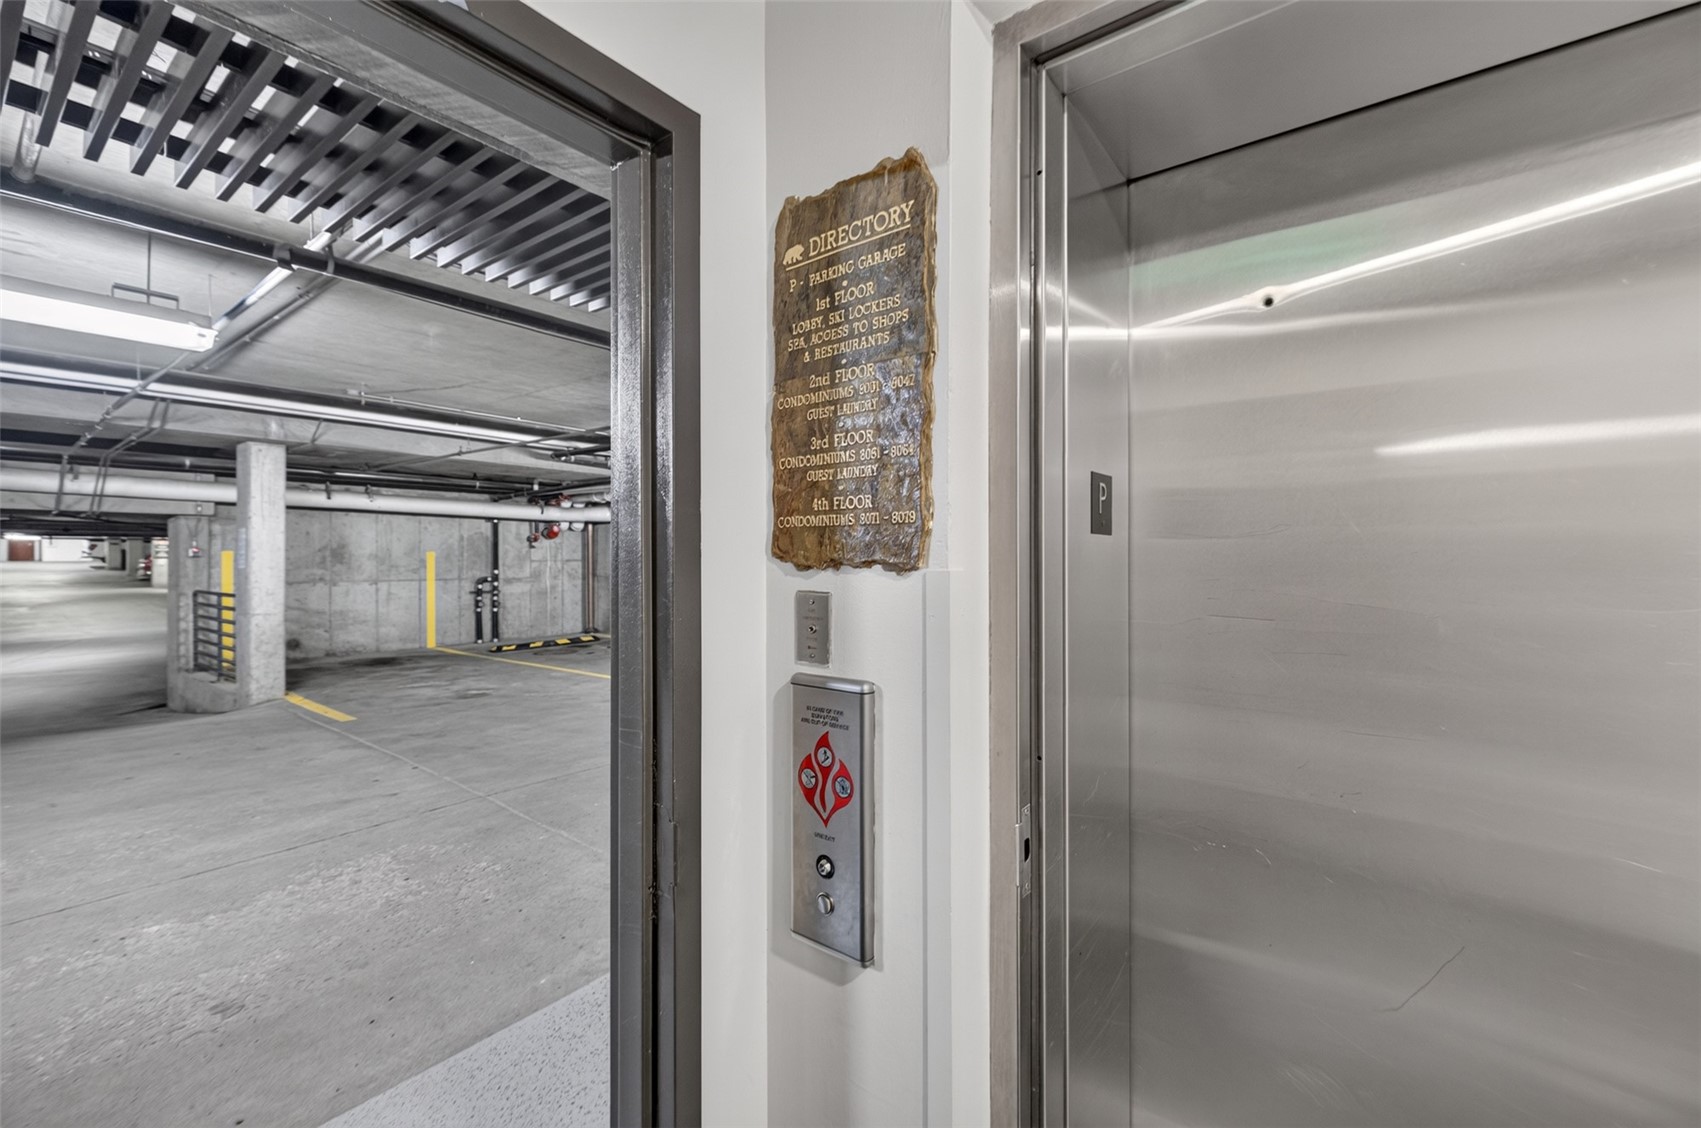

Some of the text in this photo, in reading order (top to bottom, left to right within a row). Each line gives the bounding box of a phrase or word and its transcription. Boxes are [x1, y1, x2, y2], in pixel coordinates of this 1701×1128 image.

[808, 200, 914, 256] DIRECTORY
[790, 280, 797, 292] P
[808, 260, 854, 286] PARKING
[858, 243, 906, 269] GARAGE
[816, 282, 874, 312] 1st FLOOR
[829, 310, 845, 325] SKI
[848, 294, 901, 320] LOCKERS
[810, 324, 850, 346] ACCESS
[852, 320, 868, 336] TO
[872, 308, 910, 330] SHOPS
[803, 331, 890, 363] & RESTAURANTS
[809, 363, 875, 388] 2nd FLOOR
[777, 385, 854, 410] CONDOMINIUMS
[806, 398, 878, 420] GUEST LAUNDRY
[810, 429, 874, 450] 3rd FLOOR
[780, 449, 856, 470] CONDOMINIUMS
[806, 463, 878, 482] GUEST LAUNDRY
[812, 494, 872, 512] 4th FLOOR
[1099, 482, 1107, 514] P
[777, 512, 856, 528] CONDOMINIUMS
[891, 510, 916, 524] 8079
